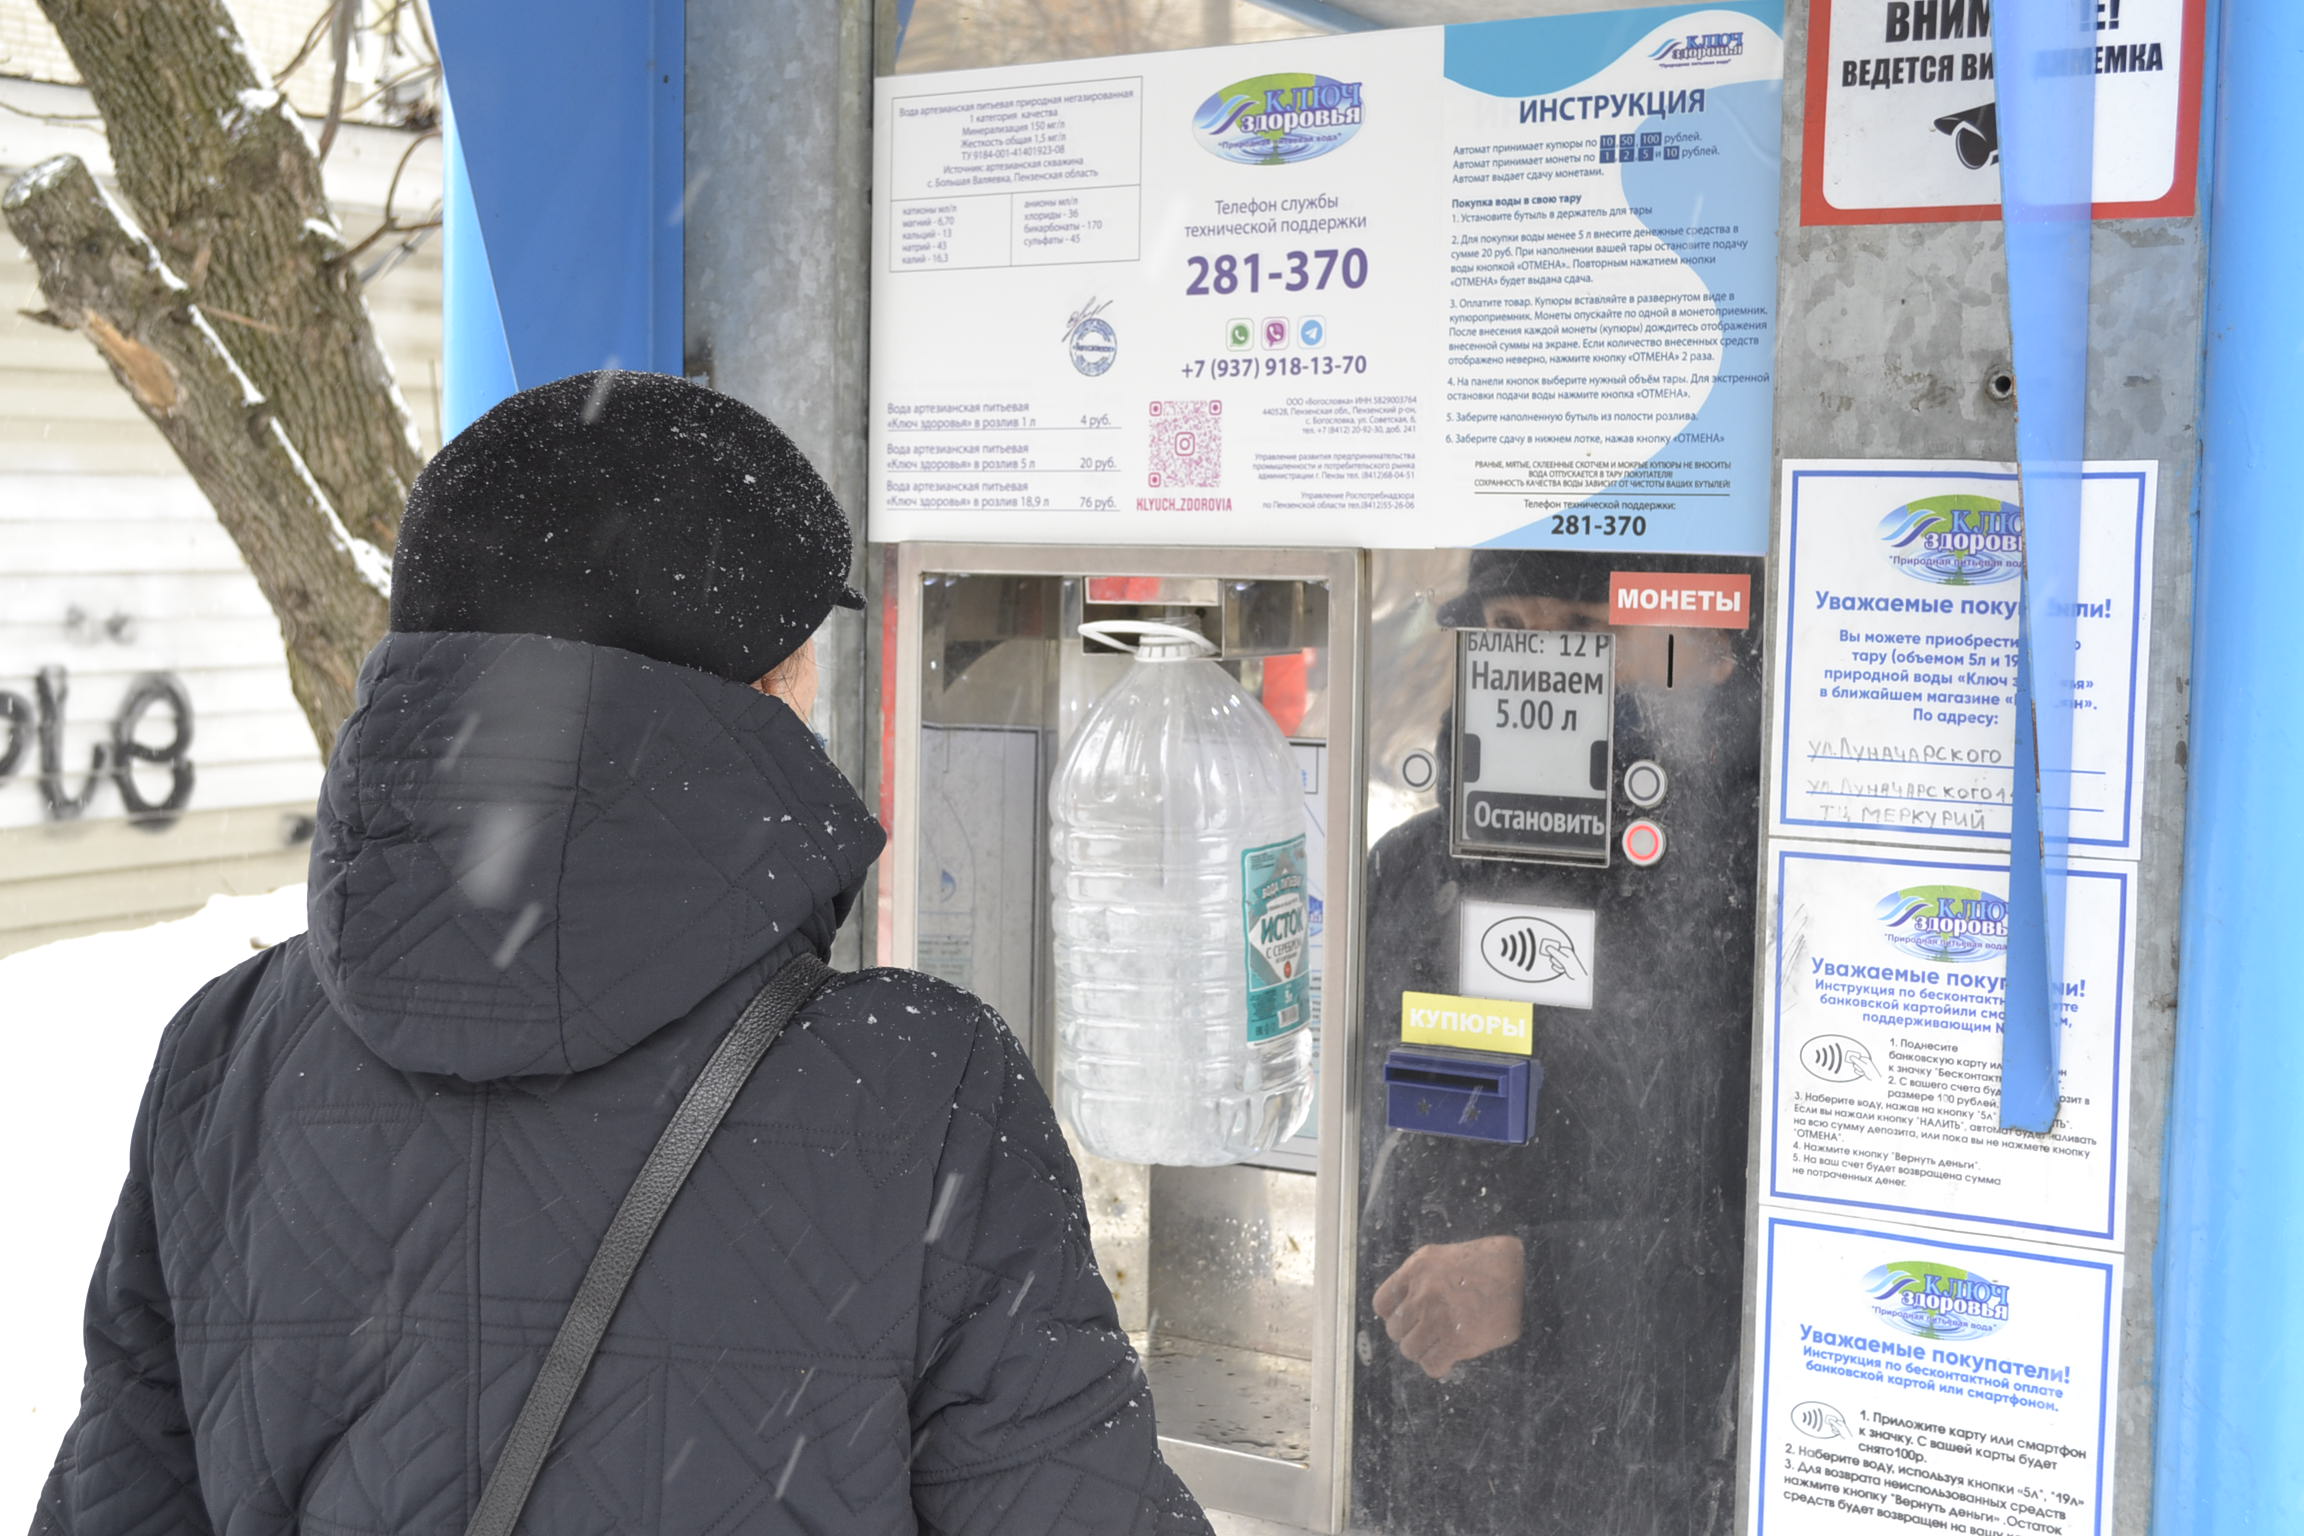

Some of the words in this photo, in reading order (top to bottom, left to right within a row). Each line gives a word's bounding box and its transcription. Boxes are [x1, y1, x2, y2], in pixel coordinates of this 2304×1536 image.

[1842, 54, 1953, 89] ВЕДЕТСЯ
[1520, 90, 1704, 123] ИНСТРУКЦИЯ
[1452, 174, 1490, 183] Автомат
[1492, 172, 1525, 182] выдает
[1526, 172, 1553, 181] сдачу
[1555, 169, 1604, 178] монетами.
[1452, 199, 1493, 209] Покупка
[1495, 198, 1521, 207] воды
[1531, 196, 1557, 204] свою
[1559, 195, 1582, 204] тару
[1456, 412, 1498, 423] Заберите
[1500, 414, 1563, 423] наполненную
[1565, 411, 1599, 423] бутыль
[1601, 413, 1612, 421] из
[1614, 413, 1653, 421] полости
[1655, 411, 1699, 423] розлива.
[1524, 499, 1561, 511] Телефон
[1563, 501, 1619, 511] технической
[1622, 502, 1676, 511] поддержки:
[1551, 515, 1646, 536] 281-370
[1617, 588, 1741, 613] МОНЕТЫ
[1816, 591, 1953, 613] Уважаемые
[1467, 632, 1544, 654] БАЛАНС:
[1559, 634, 1586, 657] 12
[1840, 629, 1860, 642] Вы
[1865, 634, 1921, 644] можете
[1926, 634, 2019, 650] приобрести
[1852, 652, 1887, 665] тару
[1891, 649, 1964, 665] (объемом
[1969, 653, 1986, 666] 5л
[1991, 657, 2000, 667] и
[1472, 661, 1603, 694] Наливаем
[1824, 670, 1909, 683] природной
[1914, 673, 1952, 685] воды
[1820, 688, 1827, 697] в
[1832, 686, 1922, 701] ближайшем
[1927, 693, 2000, 705] магазине
[1496, 699, 1553, 730] 5.00
[1561, 710, 1577, 731] л
[1913, 708, 1933, 721] По
[1937, 712, 1998, 727] адресу:
[1474, 801, 1605, 836] Остановить
[1937, 897, 2008, 922] КЛЮ
[1261, 908, 1303, 945] ИСТОК
[1812, 958, 1940, 984] Уважаемые
[1409, 1008, 1525, 1038] КУПЮРЫ
[1863, 1014, 1991, 1032] поддерживающим
[1900, 1039, 1958, 1052] Поднесите
[1889, 1051, 1954, 1066] банковскую
[1957, 1058, 1988, 1070] карту
[1804, 1142, 1850, 1156] Нажмите
[1853, 1150, 1888, 1162] кнопку
[1800, 1325, 1926, 1360] Уважаемые
[1932, 1350, 2070, 1383] покупатели!
[1803, 1346, 1882, 1372] Инструкция
[1885, 1361, 1902, 1371] по
[1905, 1363, 2009, 1389] бесконтактной
[2013, 1383, 2063, 1398] оплате
[1806, 1361, 1884, 1381] банковской
[1887, 1376, 1935, 1390] картой
[1939, 1384, 1963, 1395] или
[1967, 1389, 2059, 1411] смартфоном.
[1860, 1410, 1869, 1421] 1.
[1873, 1412, 1946, 1434] Приложите
[1949, 1428, 1987, 1443] карту
[1990, 1435, 2014, 1446] или
[2017, 1440, 2086, 1458] смартфон
[1858, 1443, 1927, 1463] снято100р.
[1859, 1427, 1865, 1436] к
[1869, 1429, 1913, 1445] значку.
[1917, 1435, 1927, 1447] С
[1930, 1440, 1972, 1454] вашей
[1976, 1449, 2015, 1462] карты
[2019, 1454, 2057, 1469] будет
[1785, 1443, 1794, 1454] 2.
[1799, 1446, 1860, 1466] Наберите
[1863, 1459, 1894, 1474] воду,
[1898, 1466, 1964, 1485] используя
[1967, 1479, 2014, 1494] кнопки
